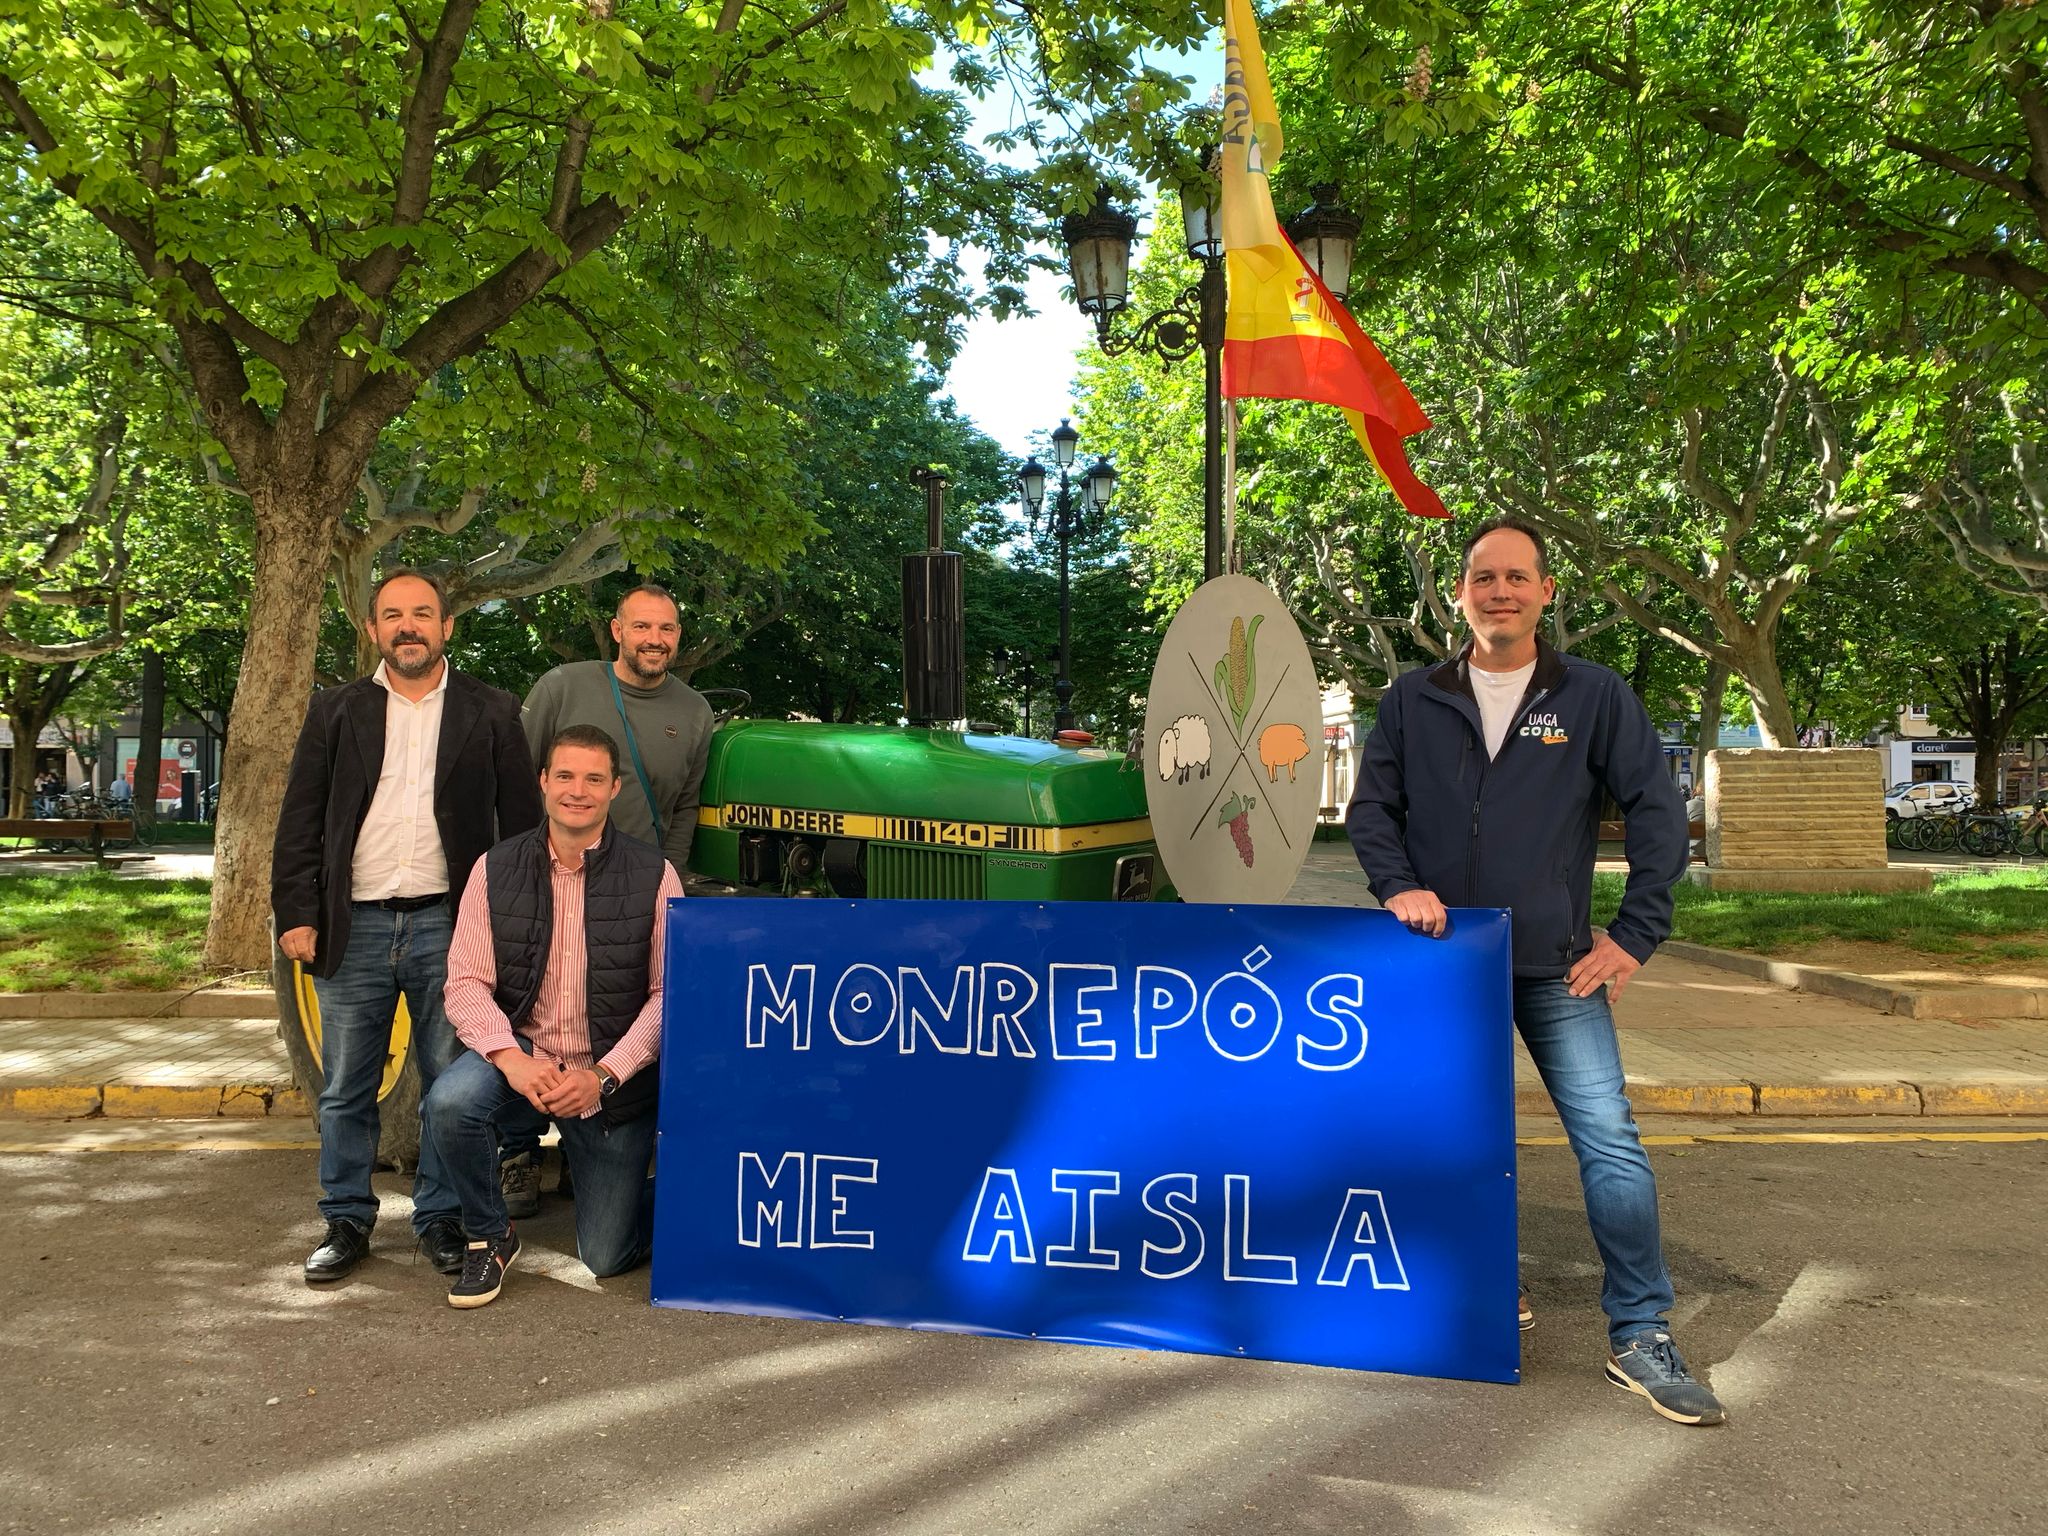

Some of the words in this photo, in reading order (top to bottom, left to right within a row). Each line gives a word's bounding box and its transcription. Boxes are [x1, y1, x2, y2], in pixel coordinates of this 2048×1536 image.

[1528, 713, 1558, 727] UAGA
[1916, 743, 1945, 753] clarel
[727, 804, 774, 829] JOHN
[780, 809, 845, 836] DEERE
[920, 820, 1008, 849] 1140F
[988, 858, 1048, 871] SYNCHRON
[745, 944, 1370, 1073] MONREPÓS
[737, 1151, 879, 1250] ME
[962, 1166, 1411, 1292] AISLA
